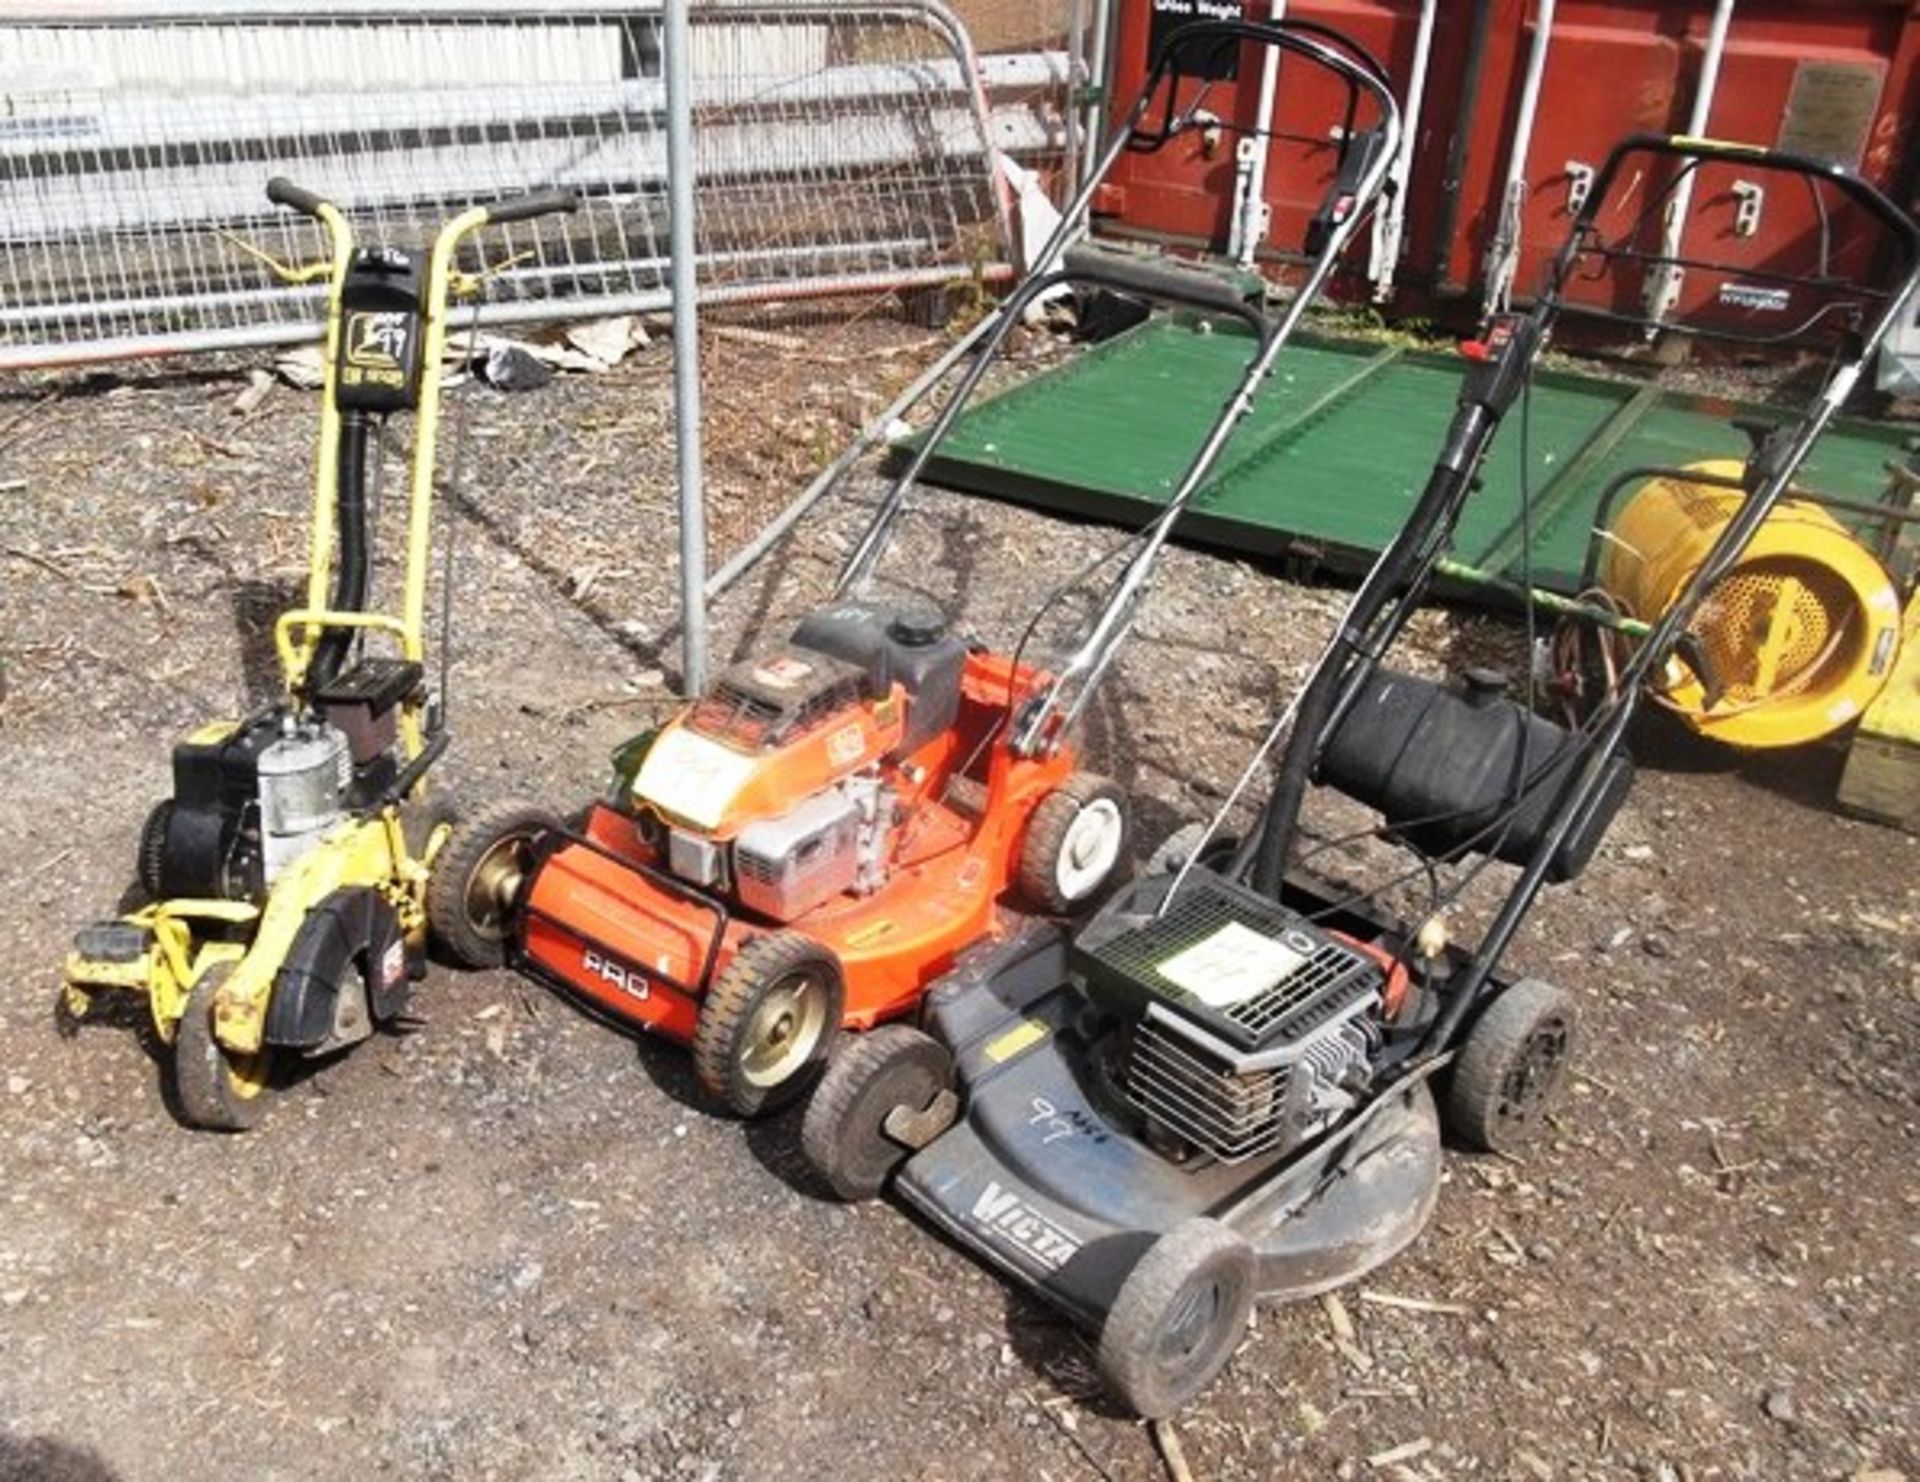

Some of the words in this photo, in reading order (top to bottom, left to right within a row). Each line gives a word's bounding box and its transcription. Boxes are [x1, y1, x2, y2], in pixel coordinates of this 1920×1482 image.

[1197, 1, 1241, 21] Weight
[583, 950, 649, 1000] PRO
[972, 1181, 1081, 1268] VICTA
